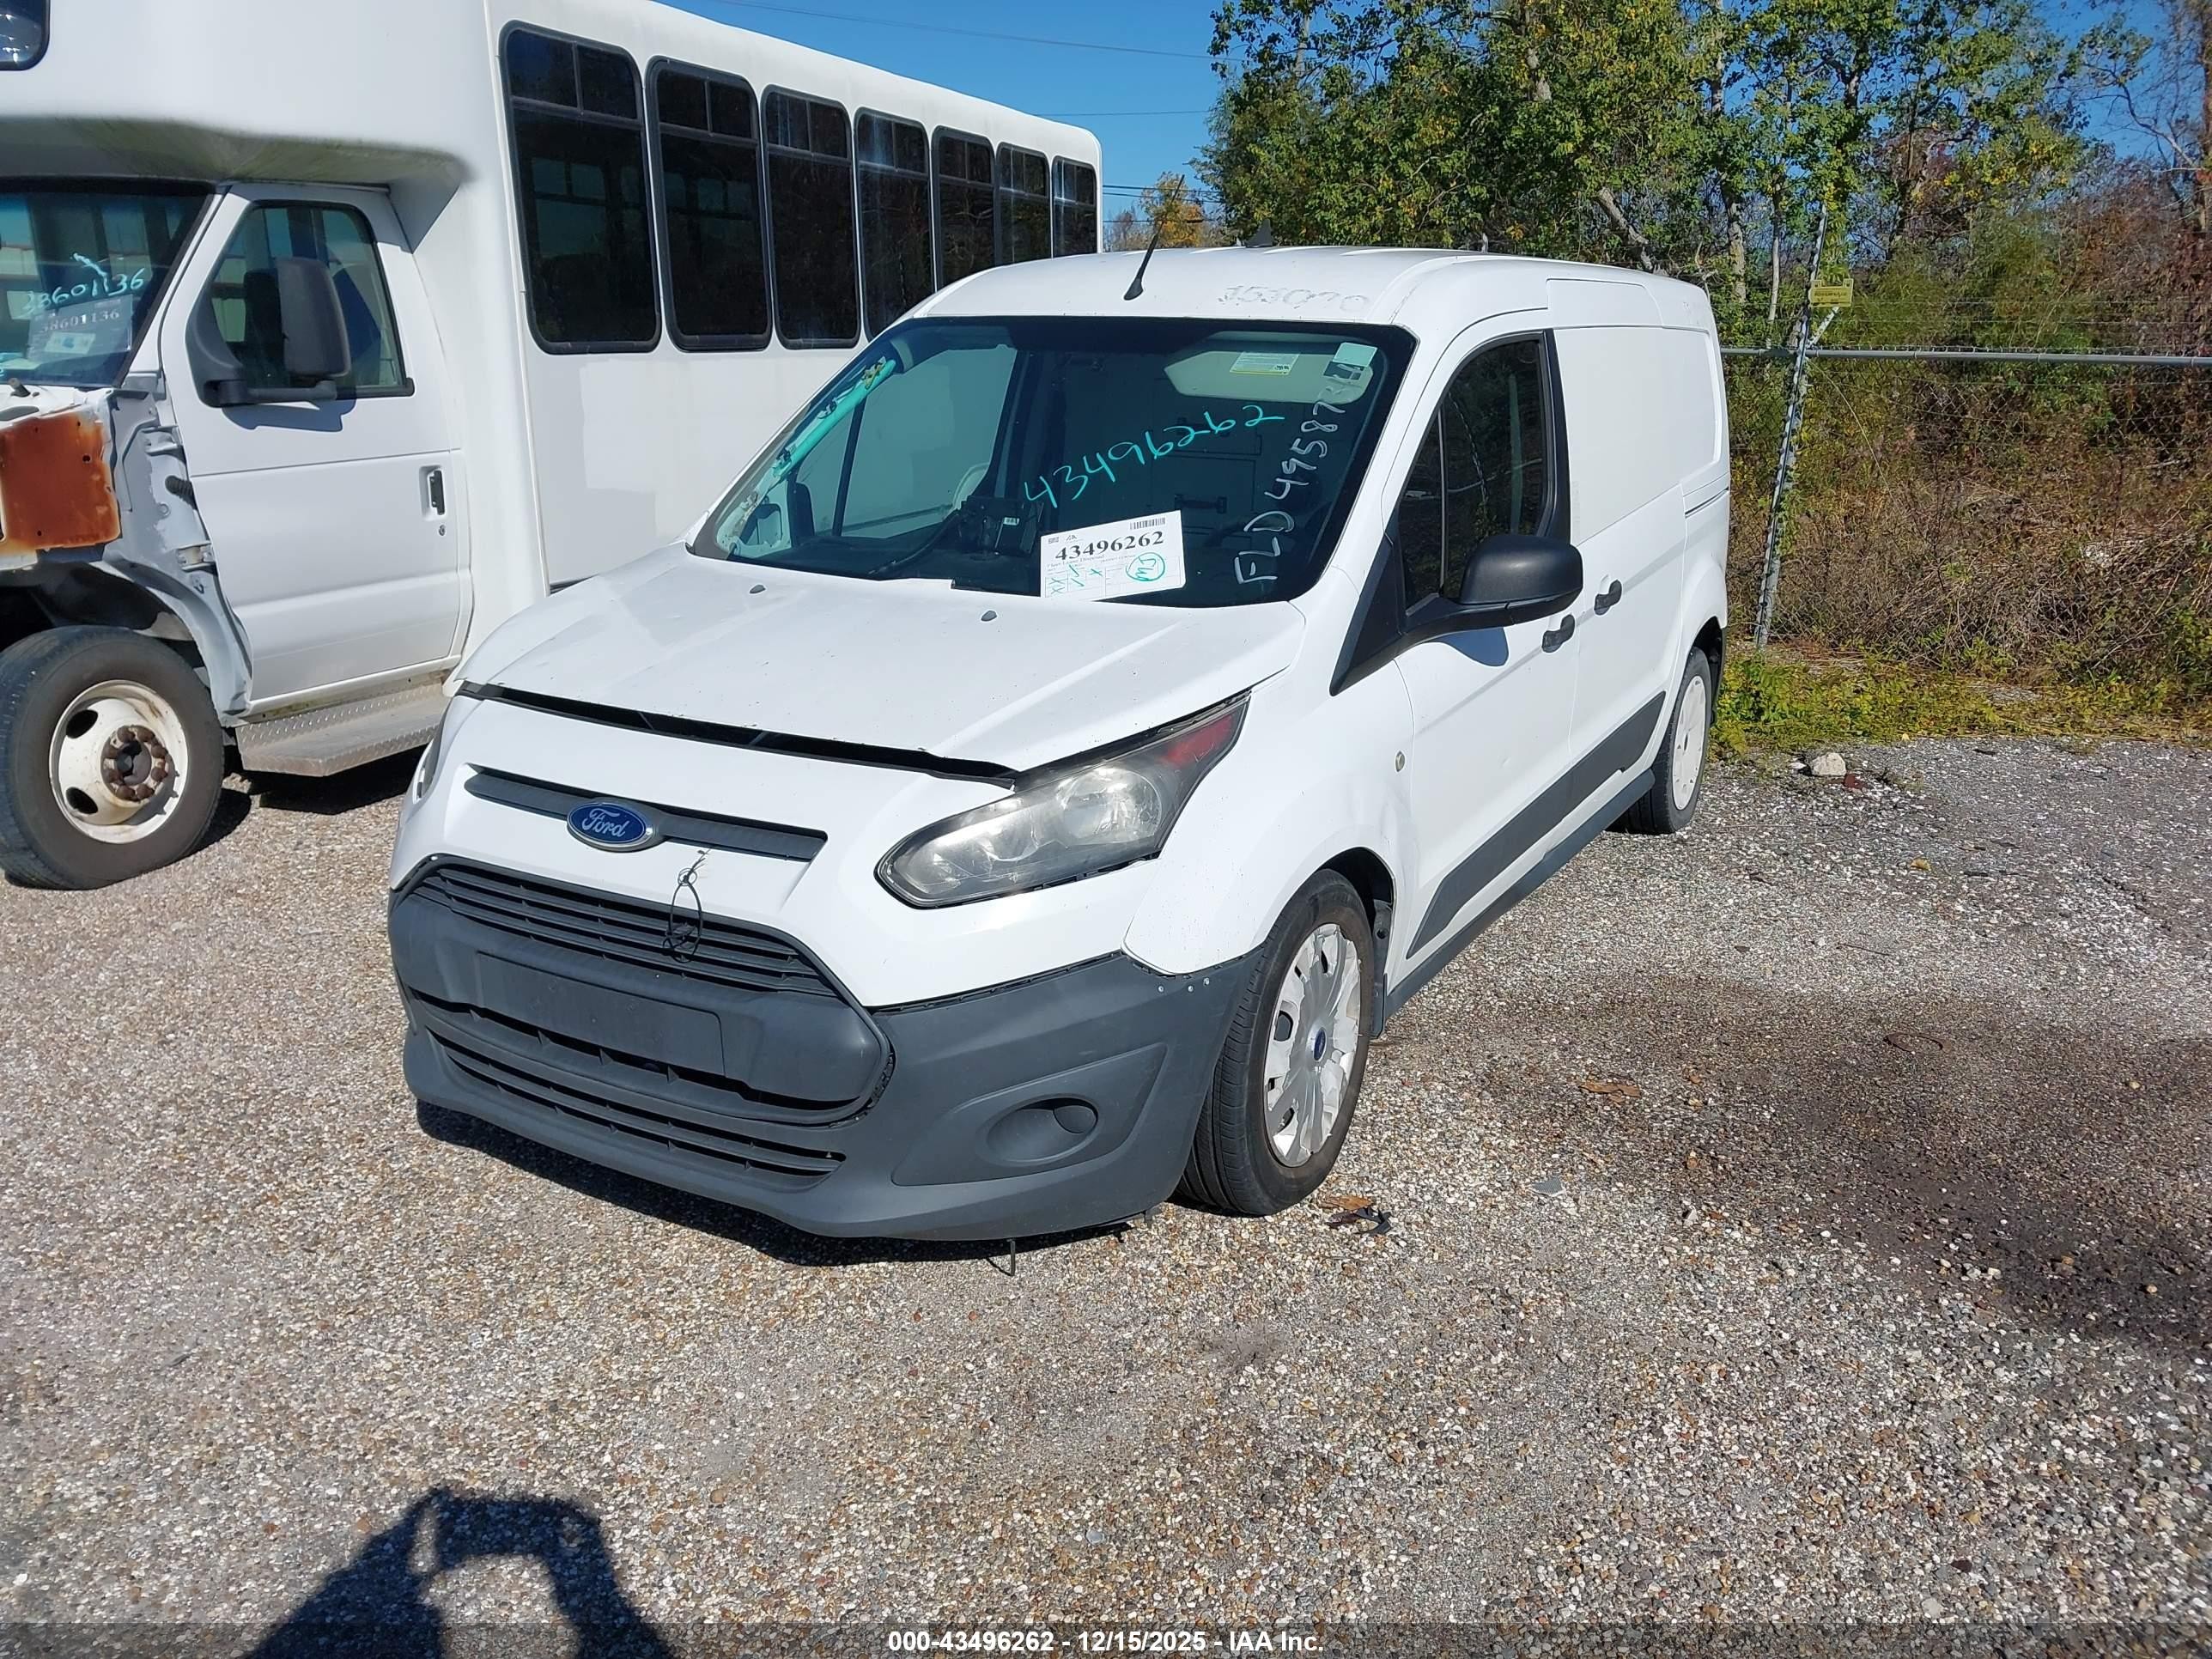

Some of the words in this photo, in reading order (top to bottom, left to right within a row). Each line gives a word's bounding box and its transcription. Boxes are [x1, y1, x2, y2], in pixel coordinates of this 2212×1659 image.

[1024, 404, 1285, 508] 43496262
[1055, 531, 1164, 561] 43496262
[1234, 510, 1295, 584] FLD
[581, 808, 630, 837] Ford
